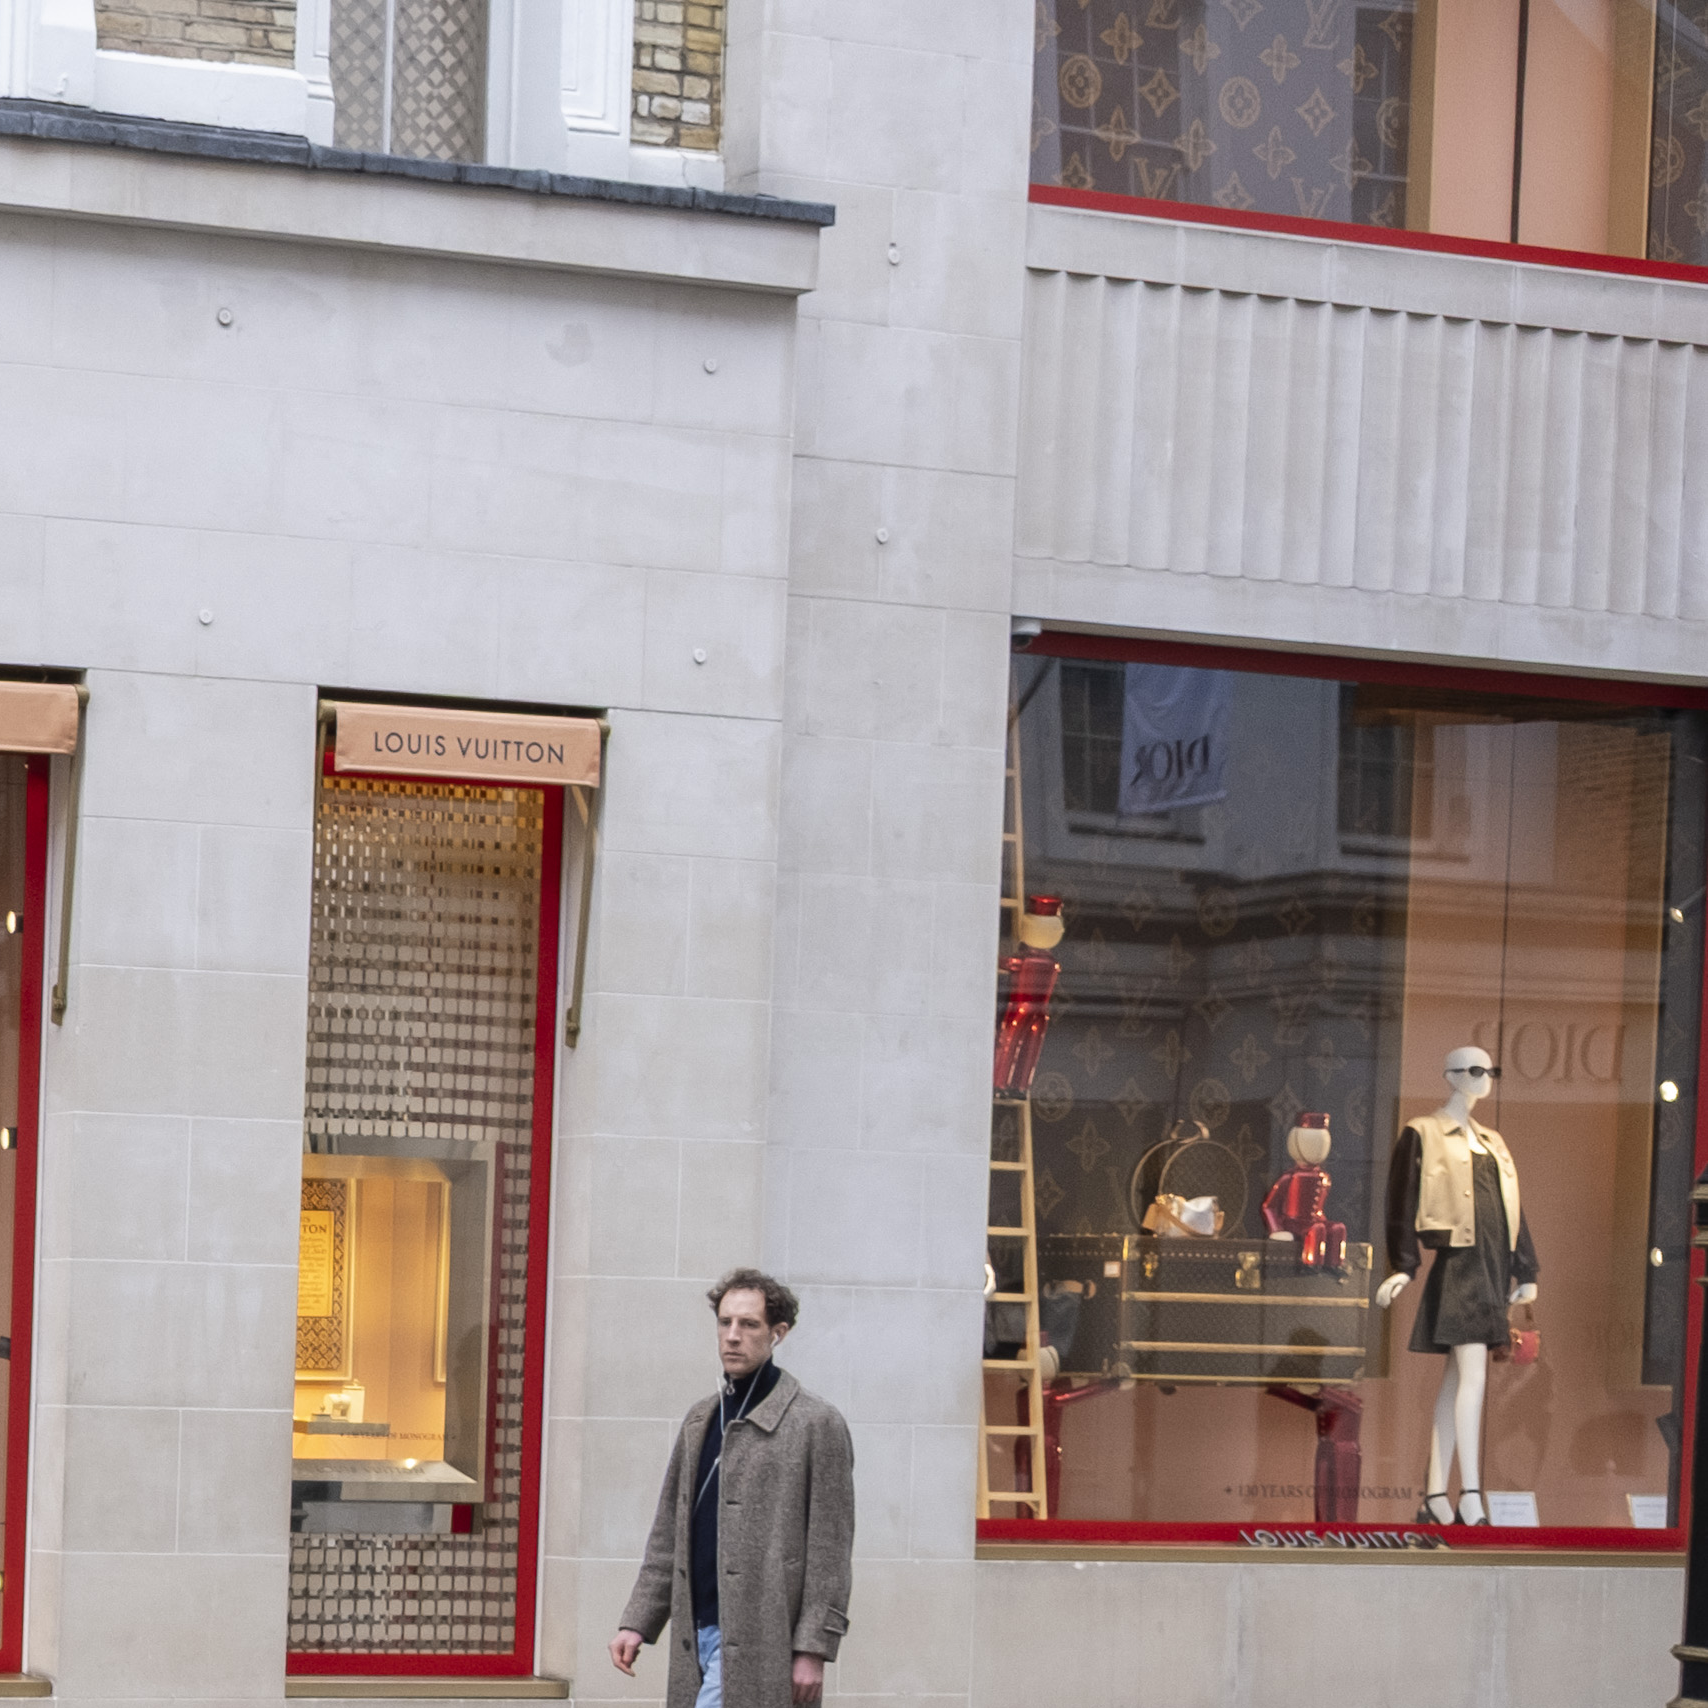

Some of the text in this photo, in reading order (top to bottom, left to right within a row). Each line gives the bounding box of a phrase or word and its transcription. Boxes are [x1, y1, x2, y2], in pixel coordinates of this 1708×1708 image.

[374, 731, 565, 765] LOUIS VUITTON
[1239, 1529, 1451, 1549] LOUIS VUITTON
